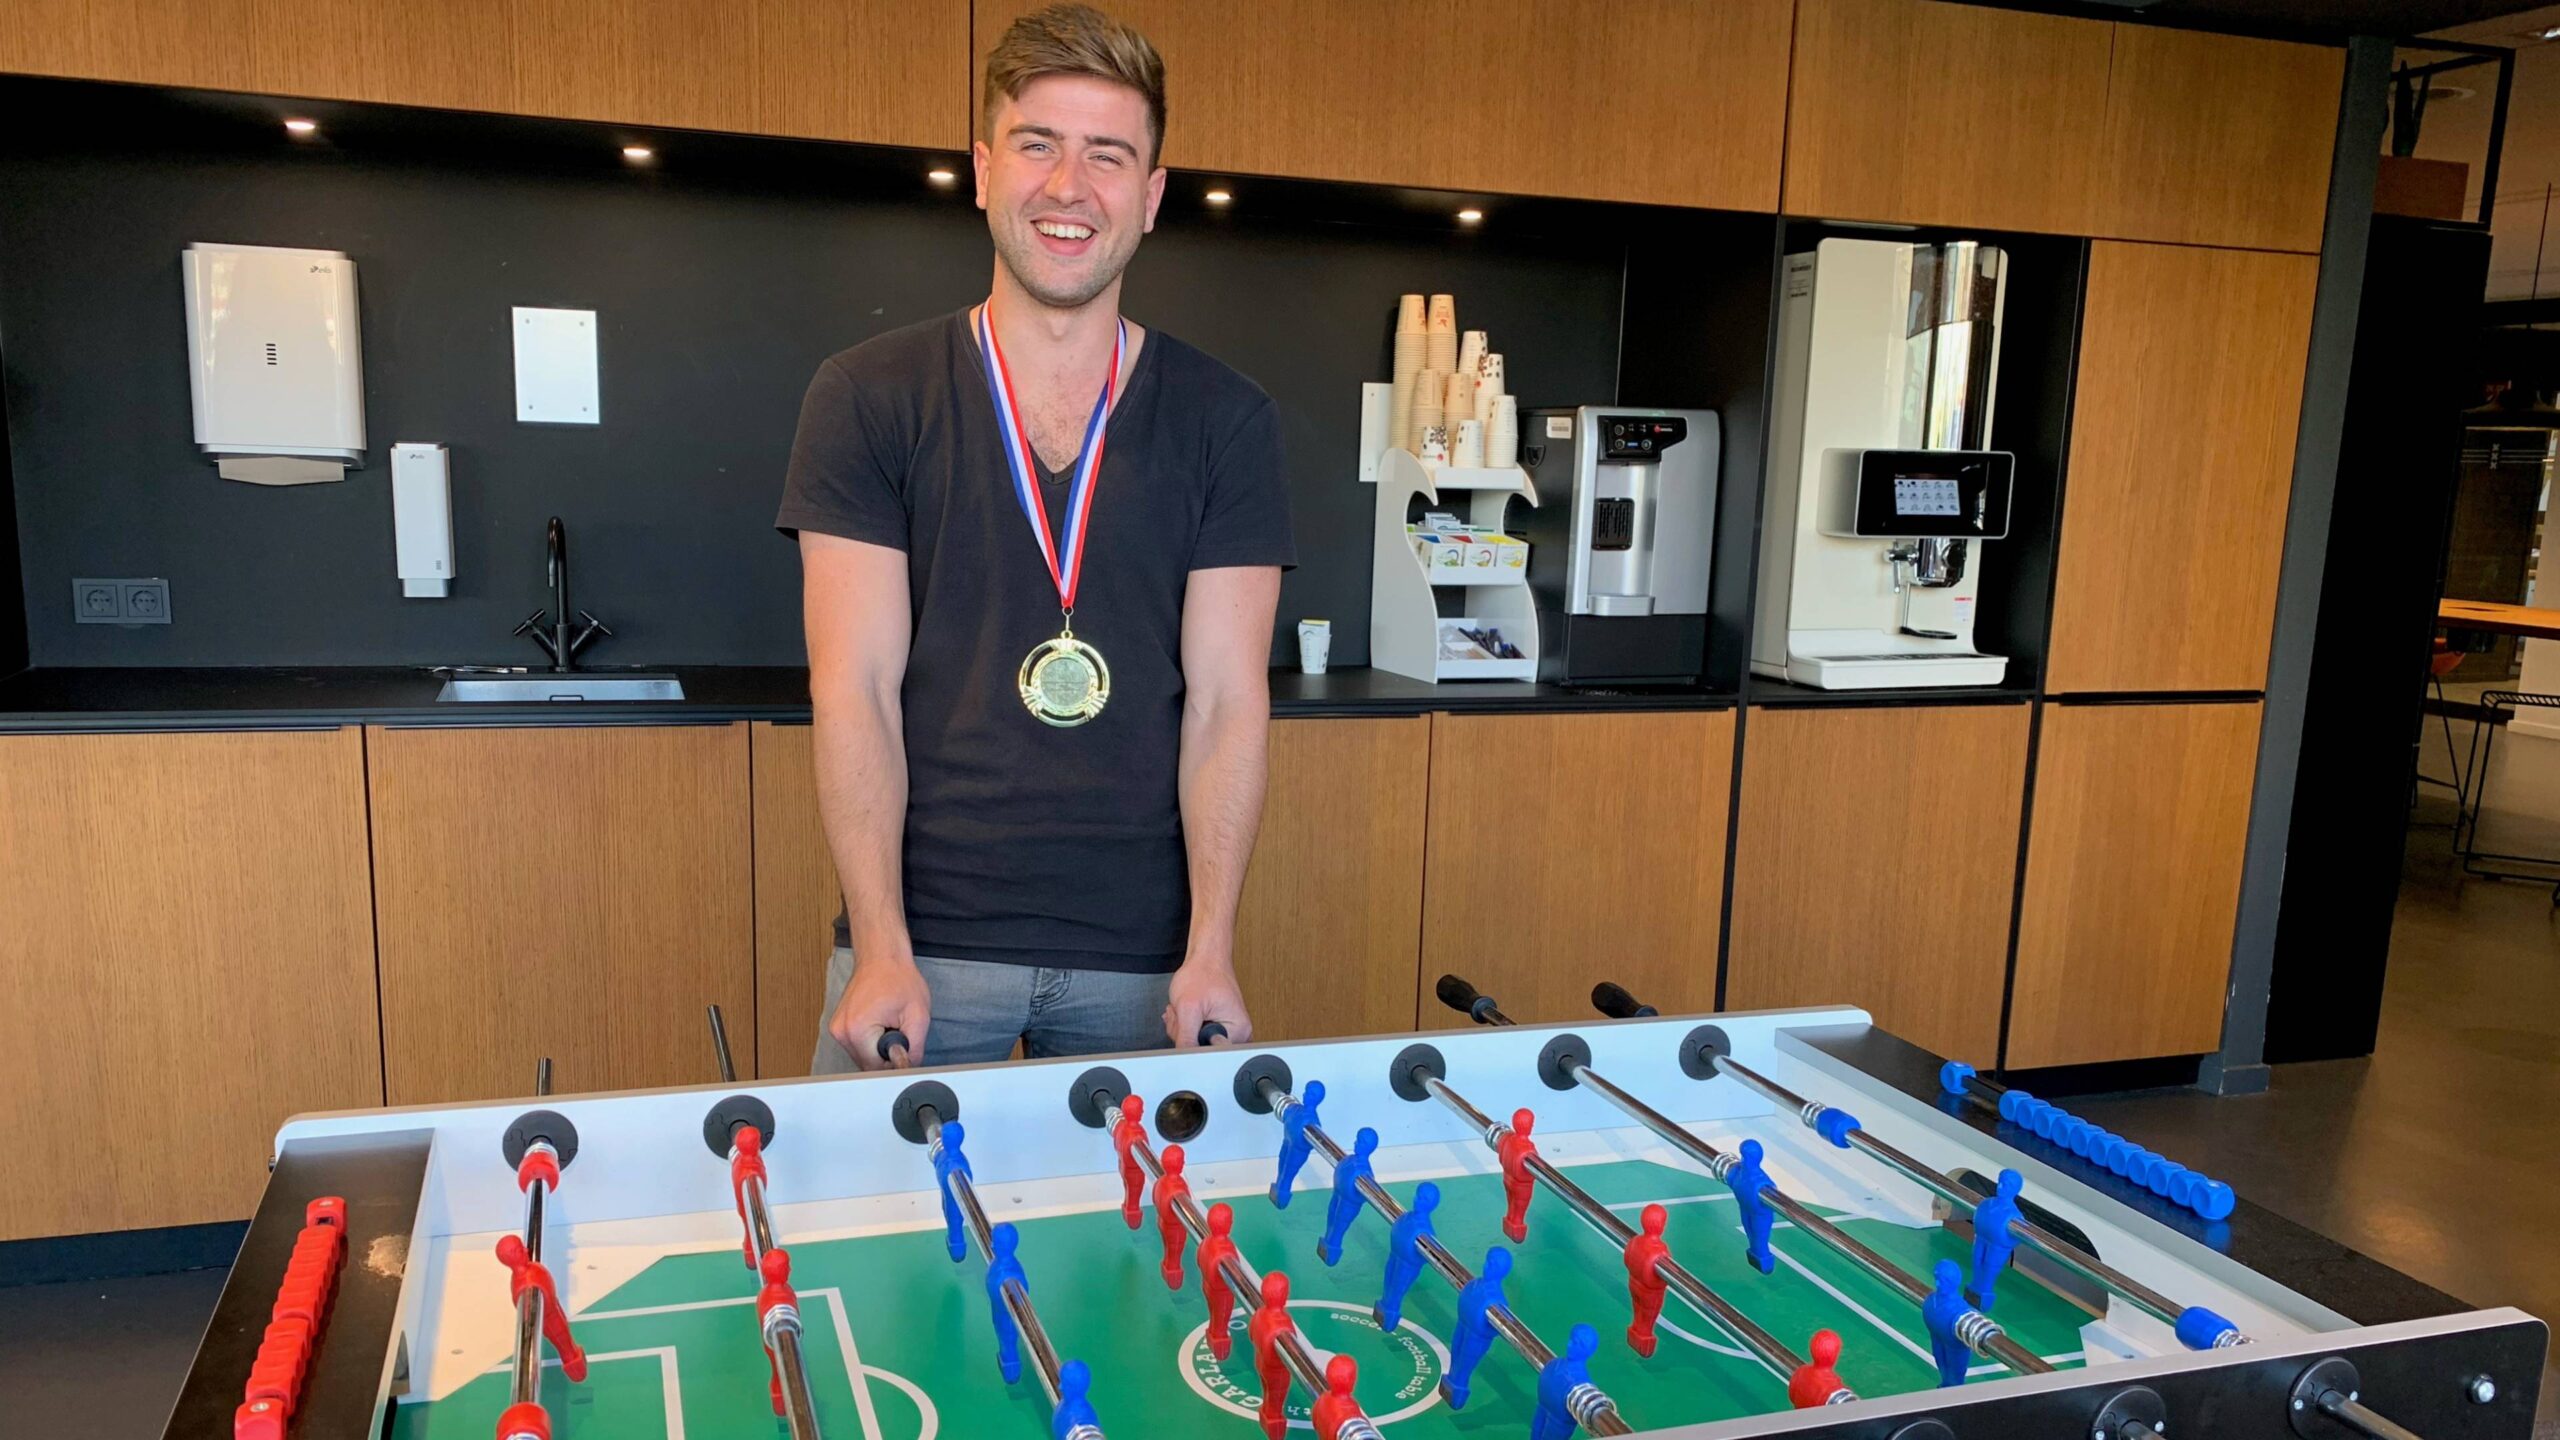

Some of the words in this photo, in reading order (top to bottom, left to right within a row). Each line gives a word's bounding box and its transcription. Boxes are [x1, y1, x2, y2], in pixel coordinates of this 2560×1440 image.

[1330, 1313, 1382, 1331] socce
[1196, 1320, 1264, 1408] GARLAO
[1398, 1336, 1431, 1374] football
[1395, 1376, 1427, 1399] table
